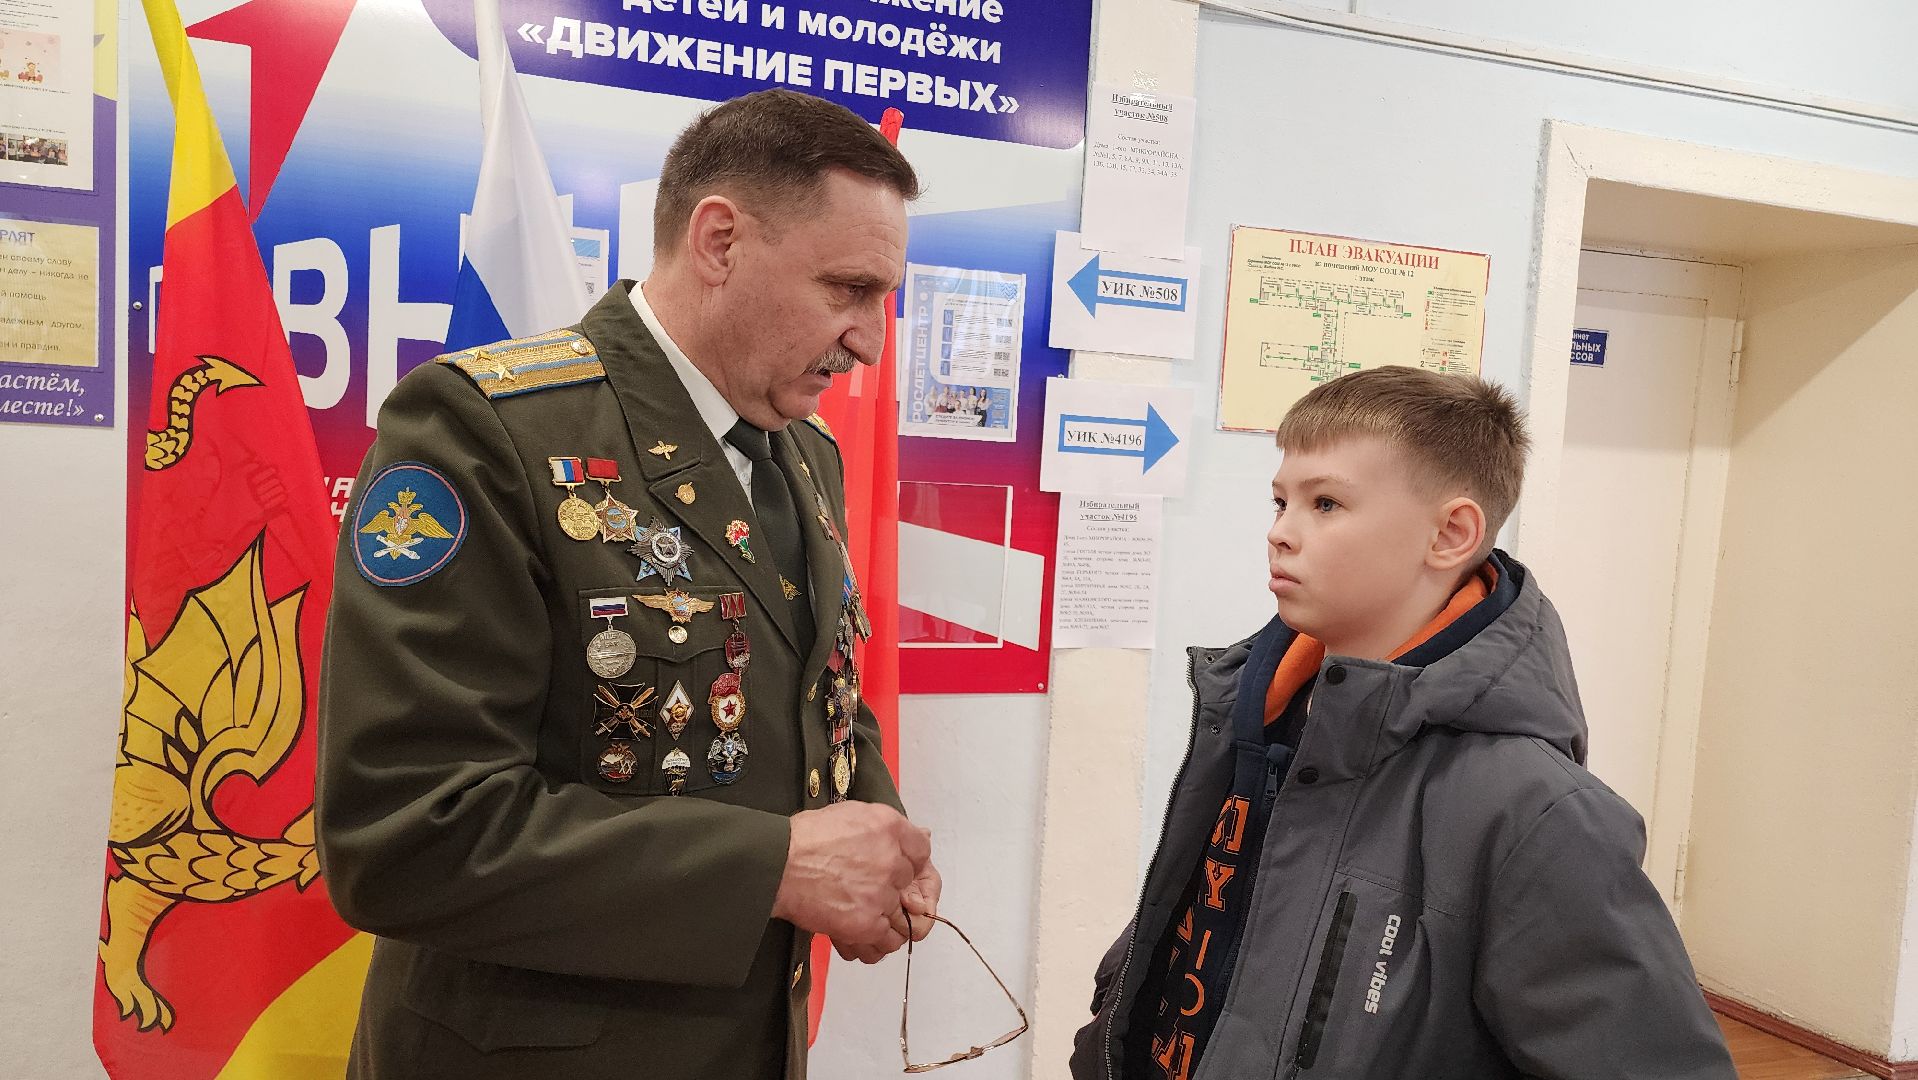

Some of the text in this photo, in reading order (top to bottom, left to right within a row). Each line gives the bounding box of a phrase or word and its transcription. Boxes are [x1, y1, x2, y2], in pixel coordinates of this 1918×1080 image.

[869, 0, 1003, 23] ение
[761, 4, 785, 29] и
[798, 10, 1001, 64] молодёжи
[517, 16, 1020, 114] «ДВИЖЕНИЕ ПЕРВЫХ»
[47, 258, 72, 267] слову
[1288, 238, 1440, 270] ПЛАН ЭВАКУАЦИИ
[1101, 280, 1178, 302] УИК №508
[0, 372, 86, 397] астём,
[1066, 430, 1142, 446] УИК №4196
[1364, 914, 1401, 1014] cool vibes
